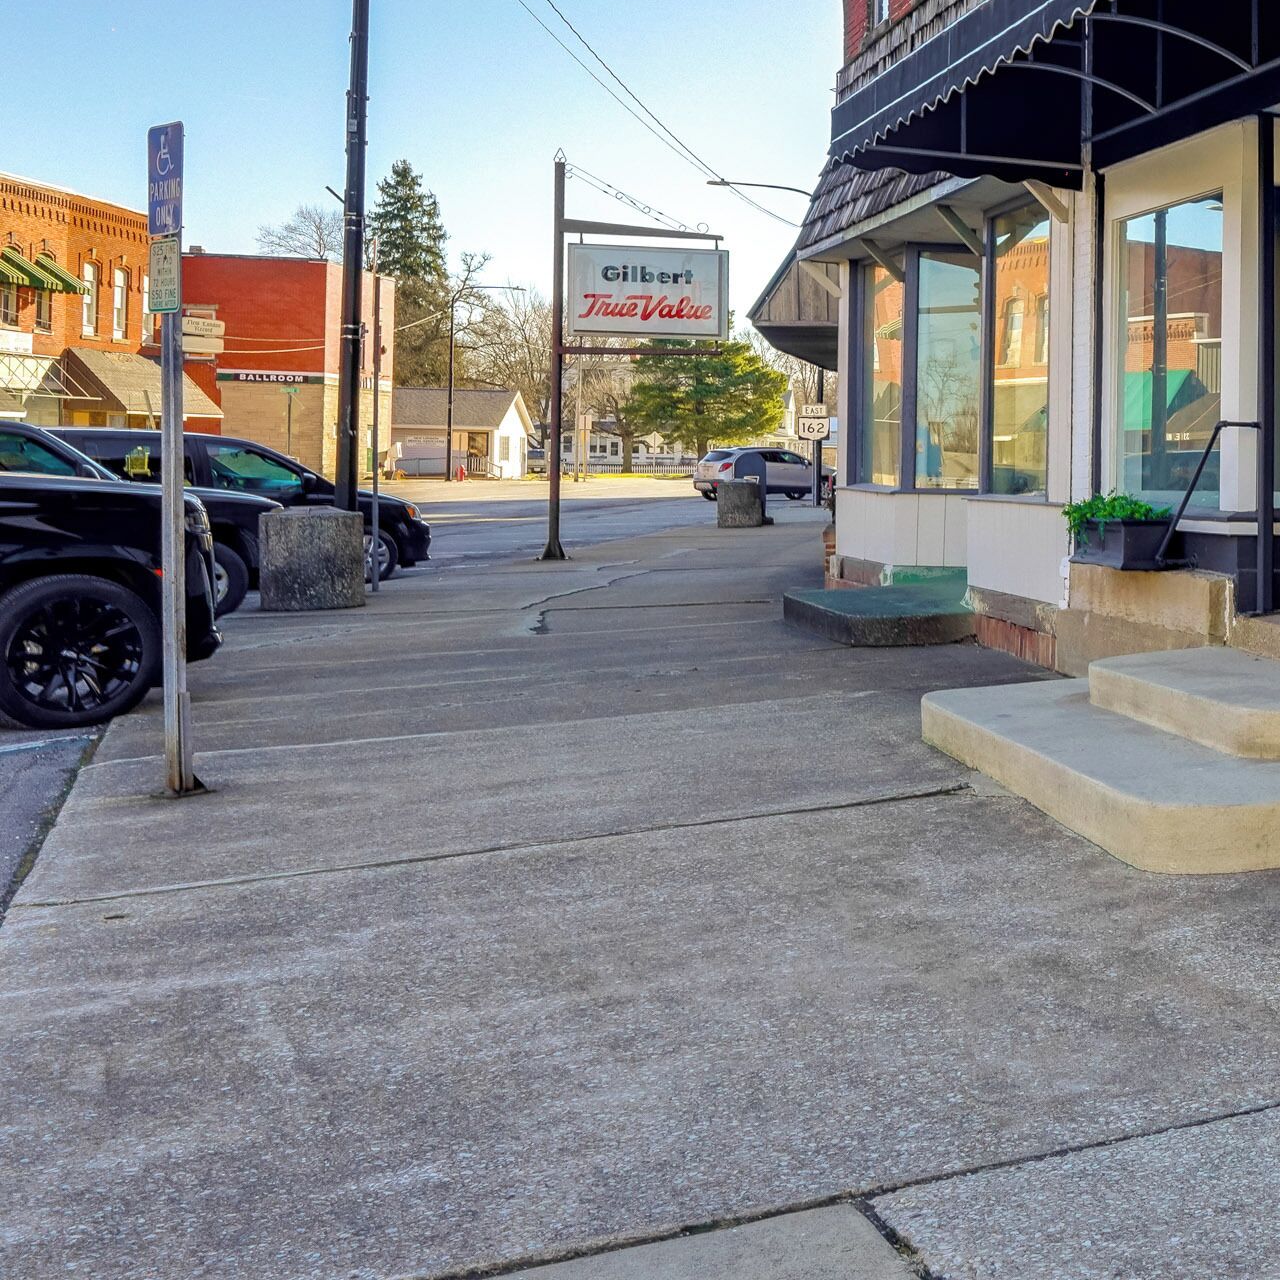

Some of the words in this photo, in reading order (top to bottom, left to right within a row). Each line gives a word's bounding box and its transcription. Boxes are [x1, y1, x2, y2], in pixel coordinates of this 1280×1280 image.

[150, 177, 180, 202] PARKING
[155, 204, 174, 226] ONLY
[165, 243, 176, 255] FINE
[601, 264, 694, 285] Gilbert
[161, 276, 176, 287] HOURS
[165, 288, 176, 300] FINE
[578, 293, 639, 319] True
[625, 294, 713, 321] Value
[239, 372, 304, 383] BALLROOM
[805, 406, 823, 415] EAST
[802, 422, 825, 434] 162
